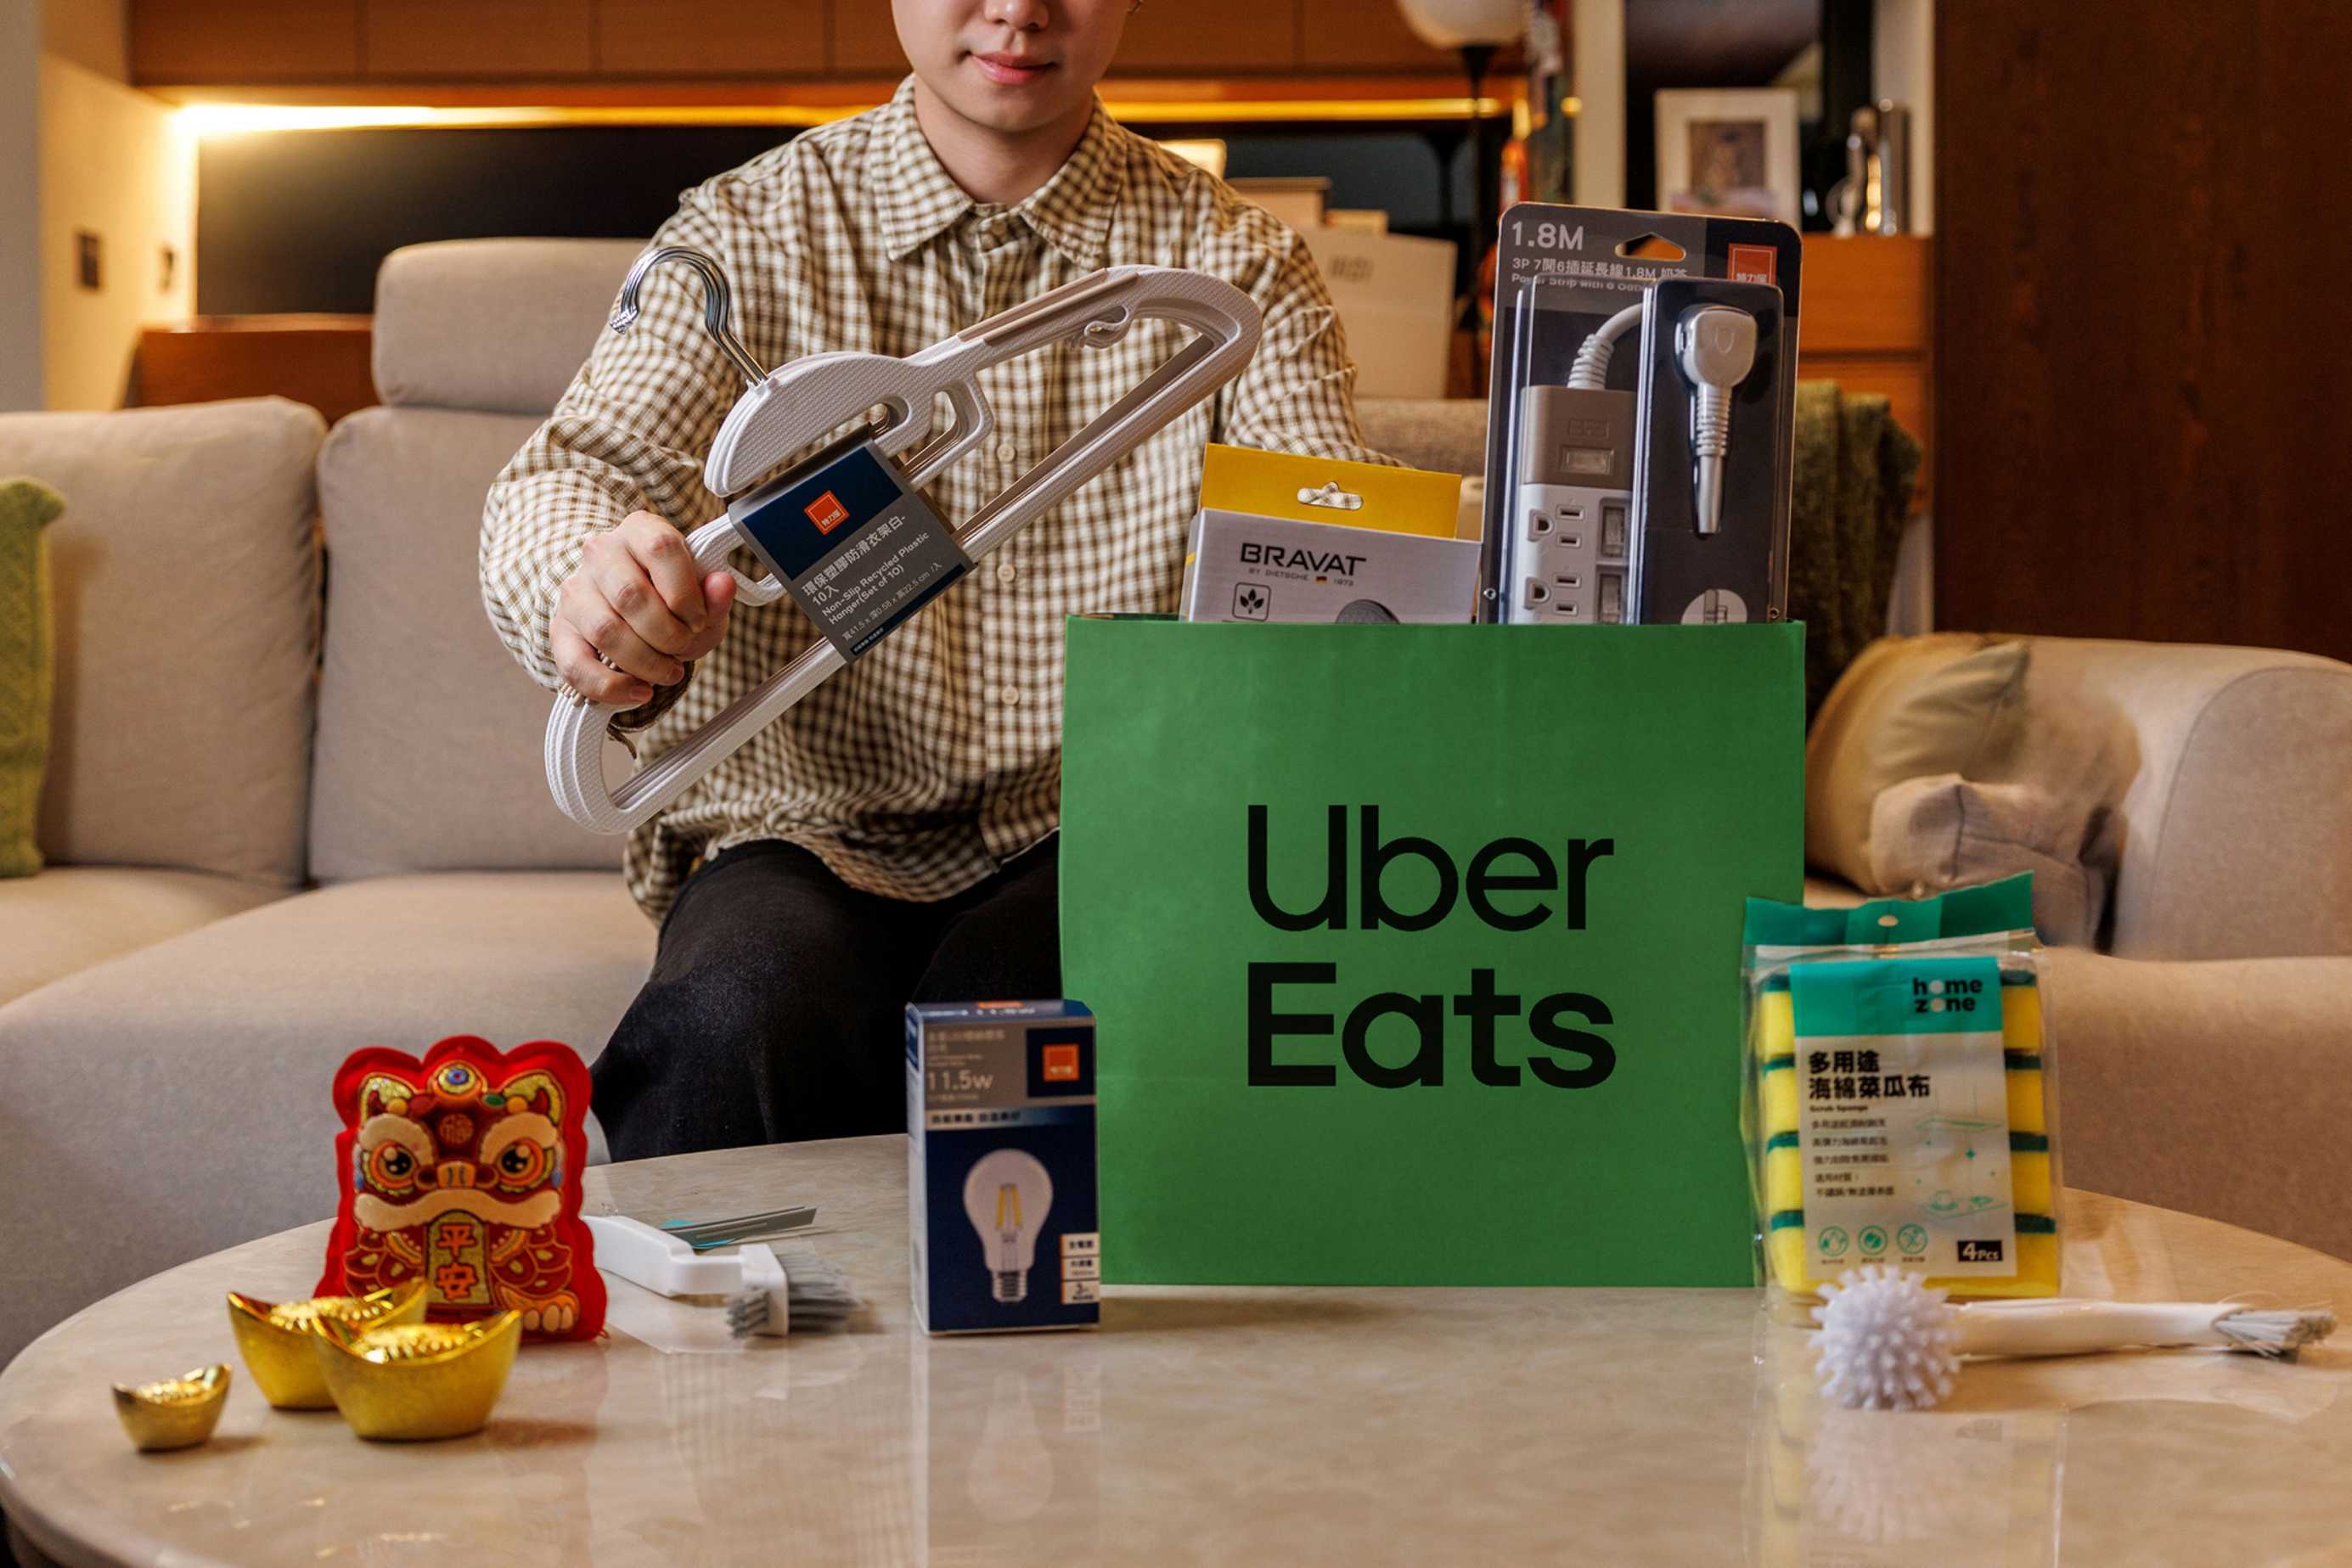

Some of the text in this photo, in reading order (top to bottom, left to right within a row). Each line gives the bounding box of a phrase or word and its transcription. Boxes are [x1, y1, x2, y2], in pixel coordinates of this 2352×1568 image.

[1512, 221, 1584, 250] 1.8M
[1513, 258, 1529, 269] 3P
[1241, 542, 1366, 576] BRAVAT
[822, 532, 929, 616] Non-Slip Recycled Plastic
[878, 576, 888, 587] of
[887, 565, 904, 580] 10)
[813, 586, 839, 606] 10入
[1248, 805, 1614, 931] Uber
[1913, 977, 1983, 995] home
[1915, 997, 1975, 1013] zone
[1248, 962, 1617, 1089] Eats
[1809, 1050, 1880, 1074] 多用途
[1809, 1074, 1930, 1099] 海綿菜瓜布
[435, 1223, 479, 1301] 平安
